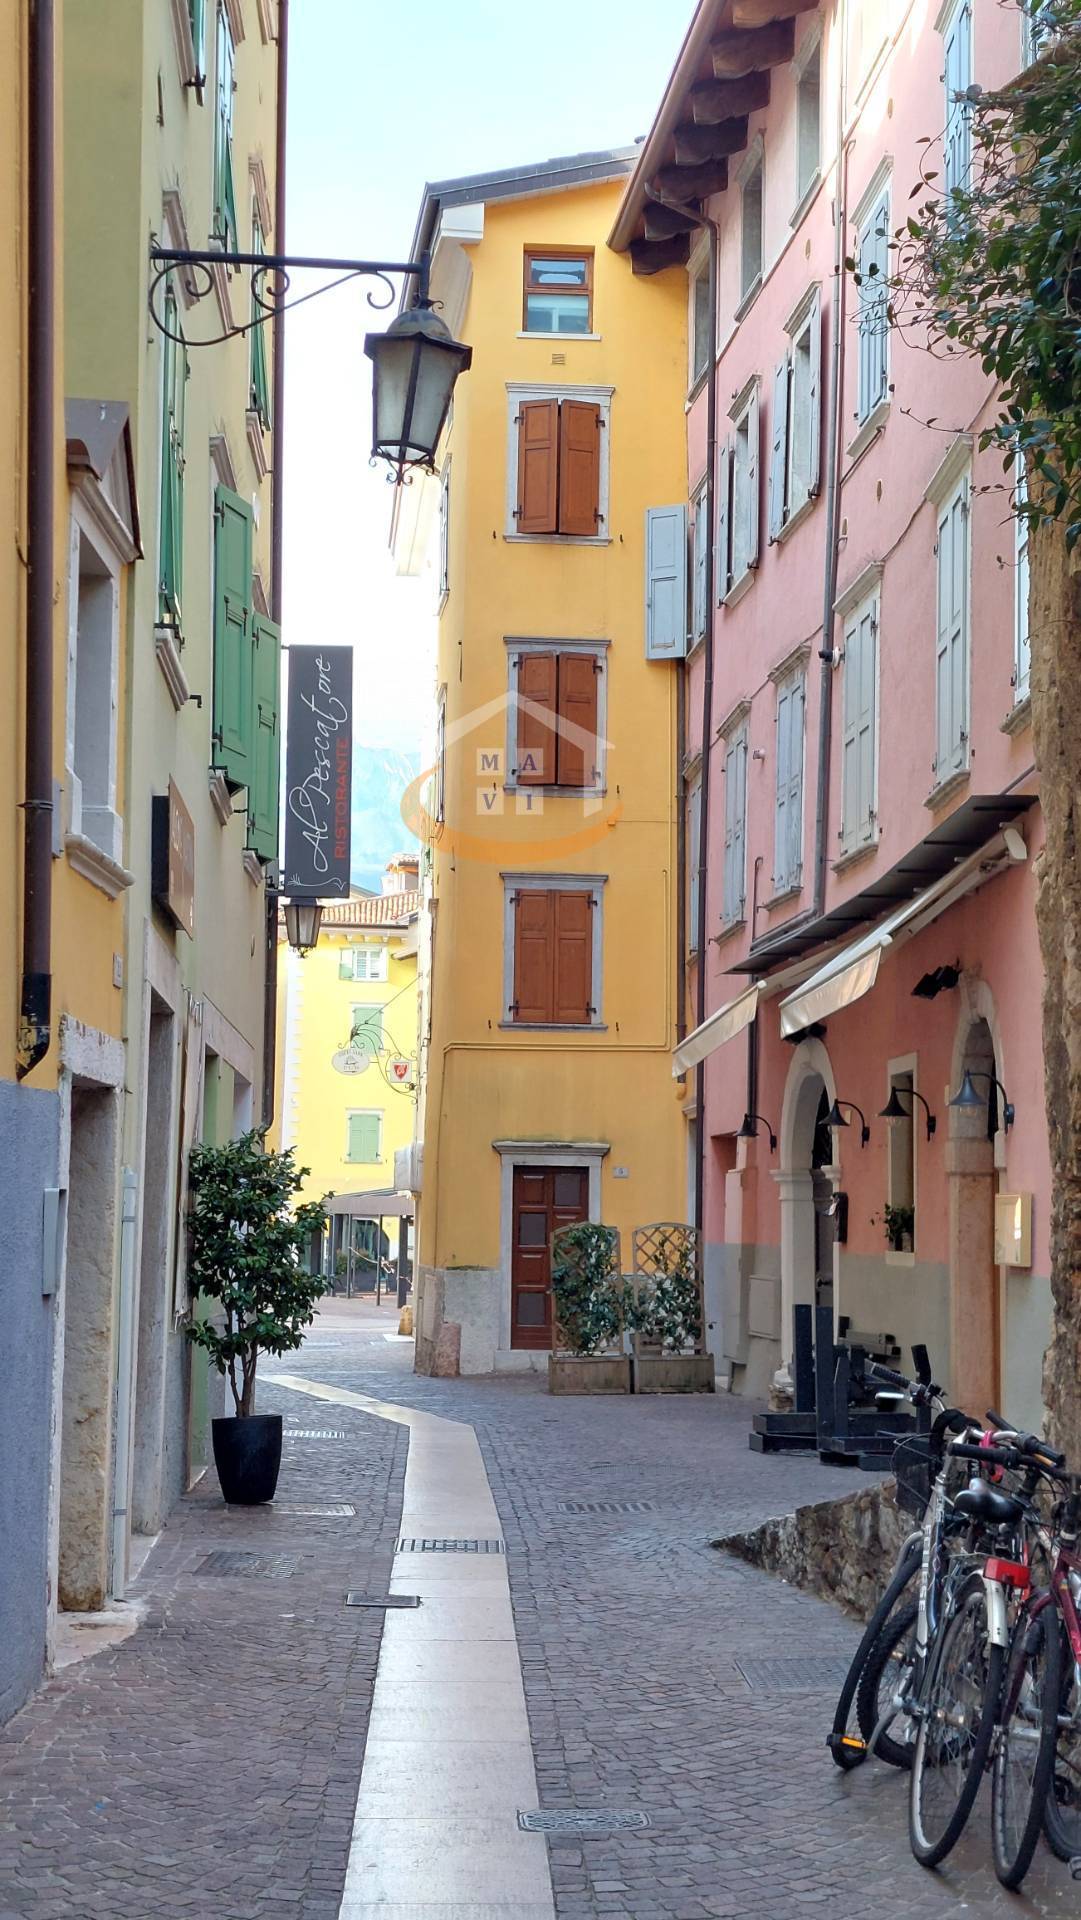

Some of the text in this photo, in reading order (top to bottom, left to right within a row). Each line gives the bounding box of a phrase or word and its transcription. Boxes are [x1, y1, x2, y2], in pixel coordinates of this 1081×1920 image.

[288, 653, 348, 873] Al Pescatore
[335, 736, 349, 859] RISTORANTE
